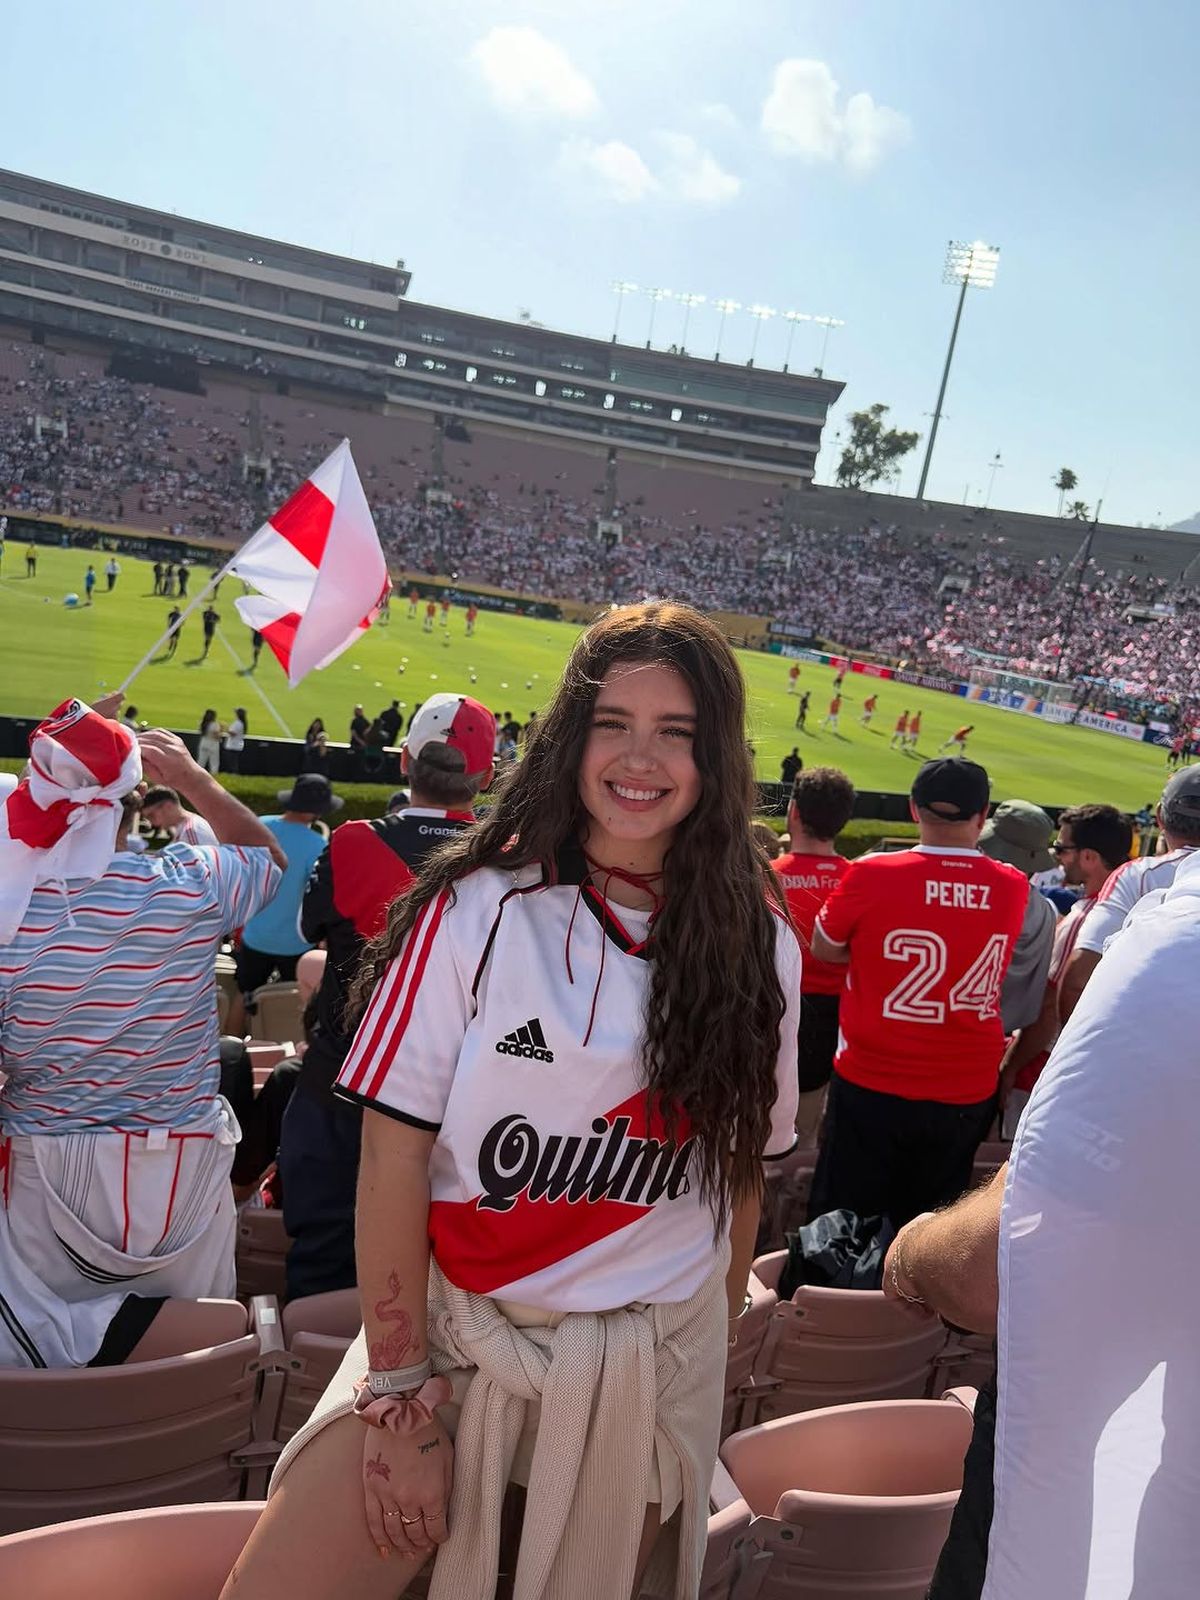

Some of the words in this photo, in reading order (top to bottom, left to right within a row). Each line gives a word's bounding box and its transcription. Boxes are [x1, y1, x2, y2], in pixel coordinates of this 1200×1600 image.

[1084, 714, 1128, 733] AMERICA
[925, 880, 991, 910] PEREZ
[882, 928, 1009, 1025] 24
[495, 1041, 554, 1063] adidas
